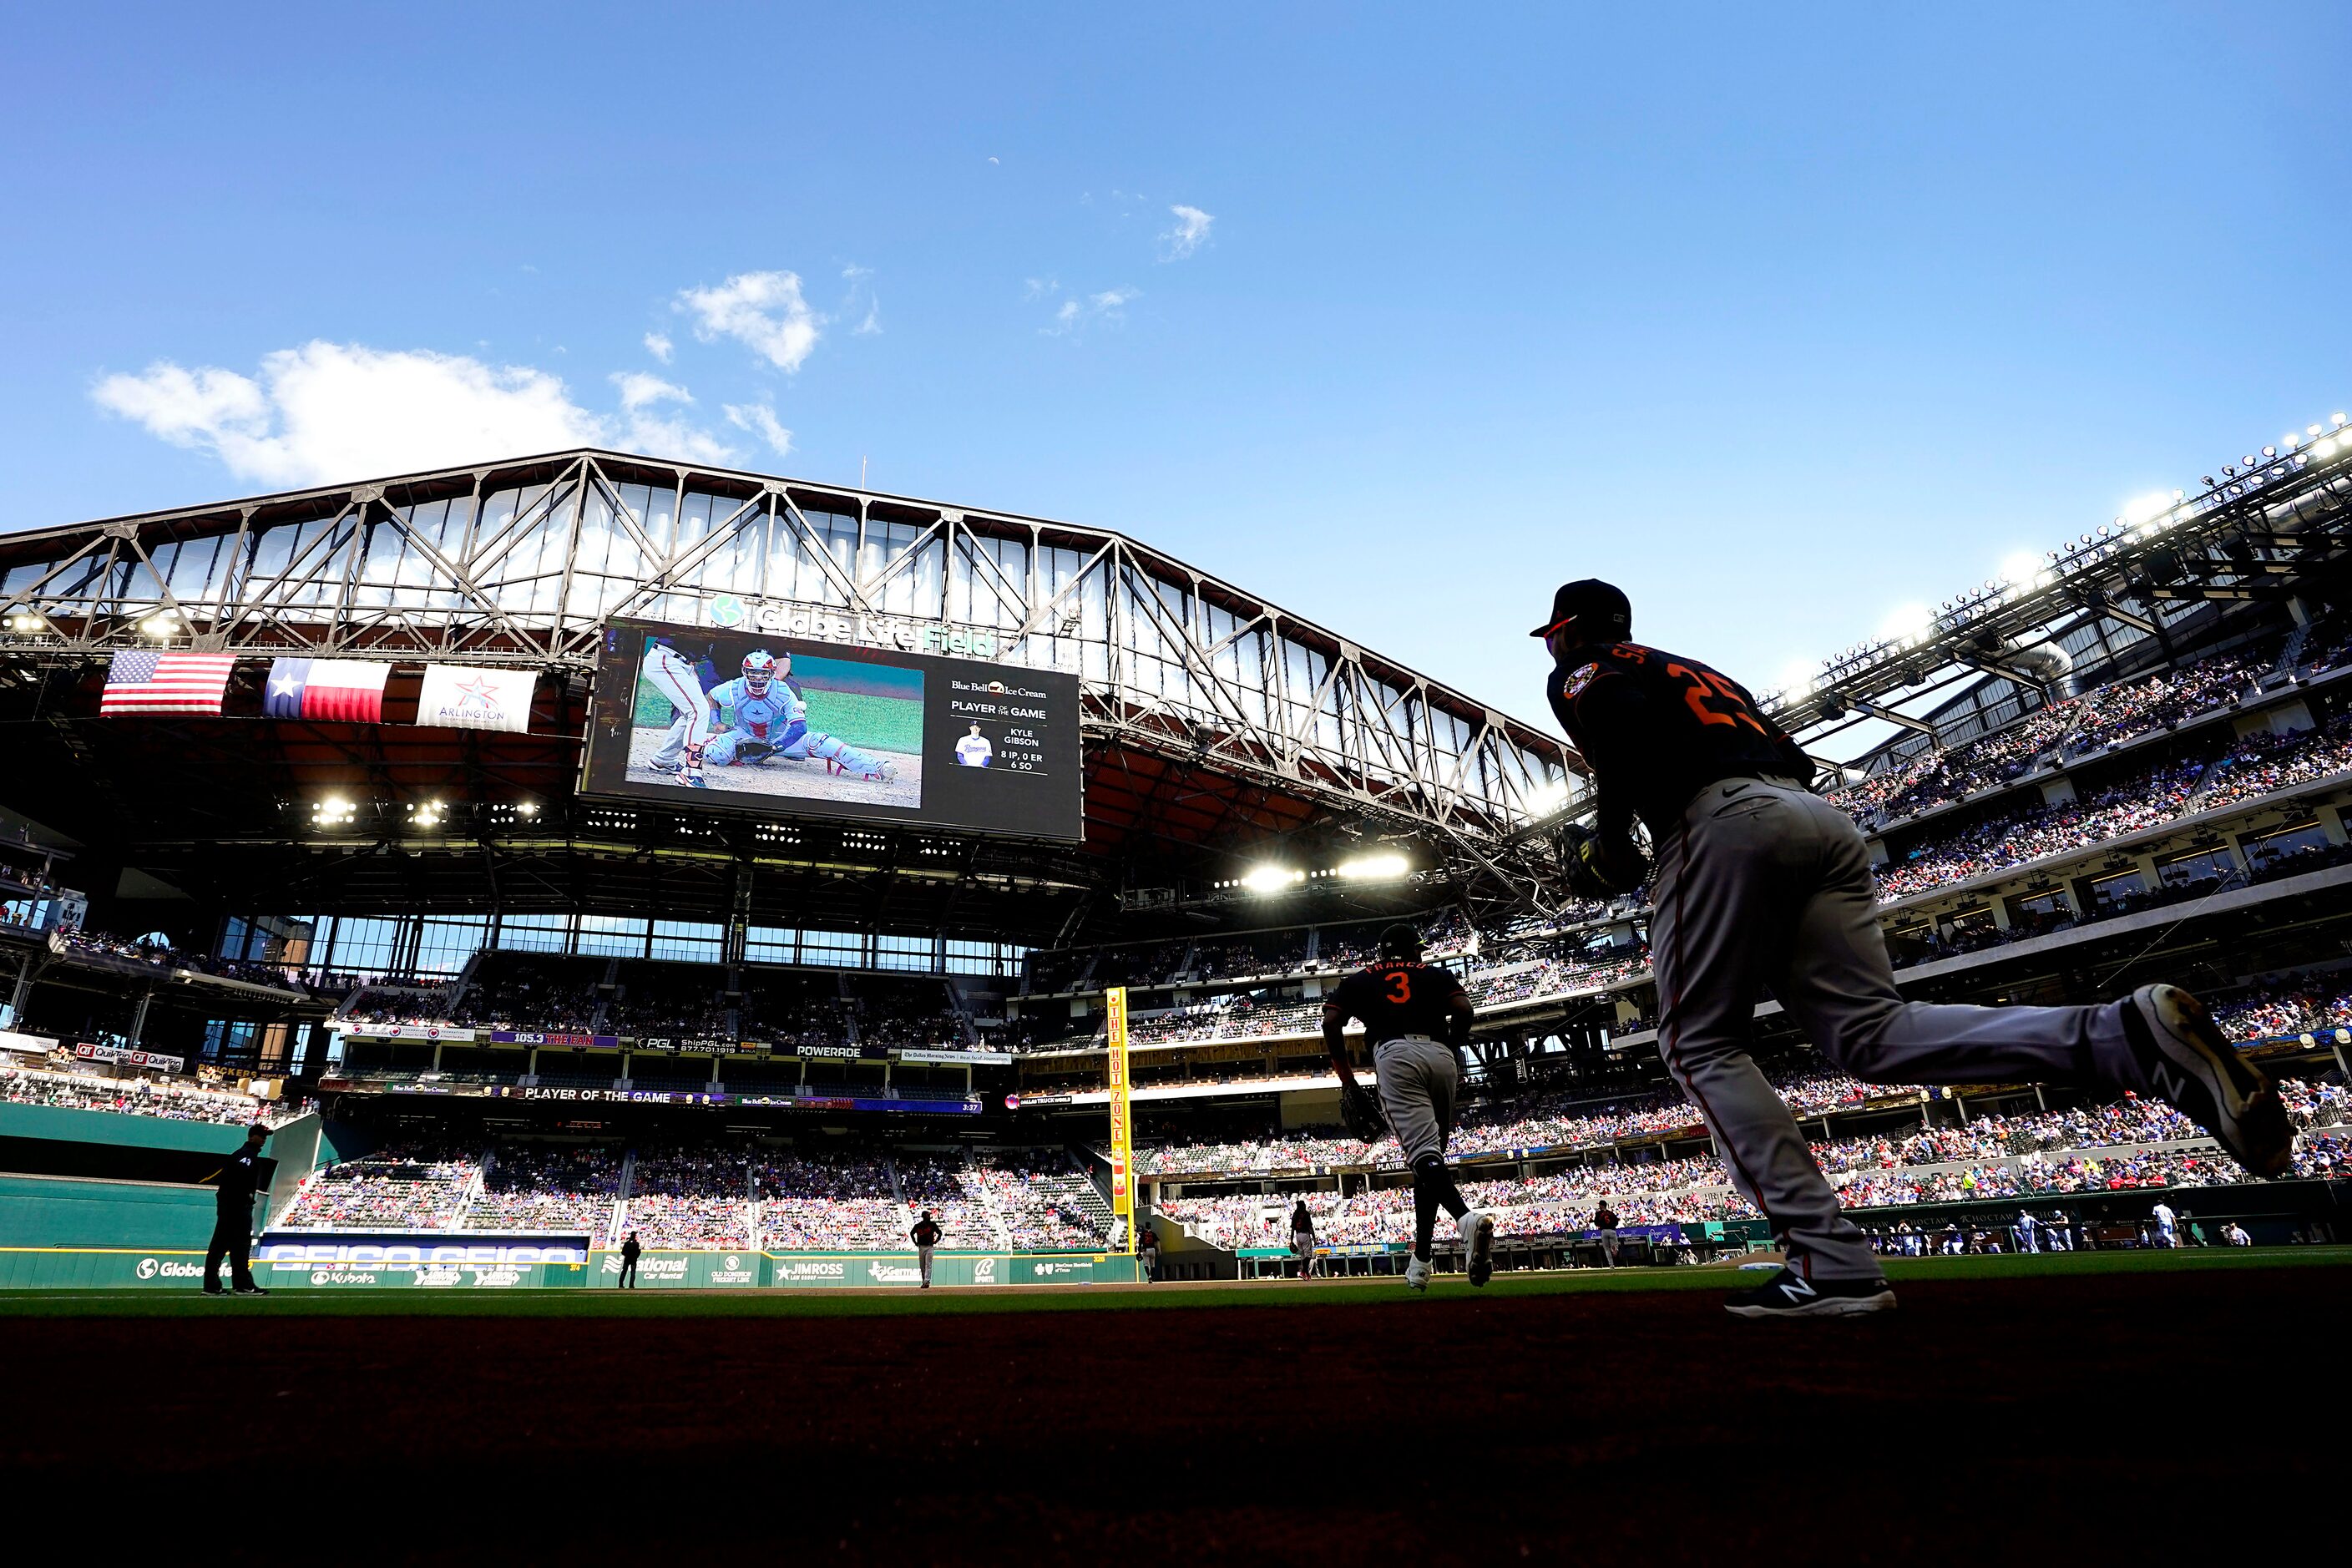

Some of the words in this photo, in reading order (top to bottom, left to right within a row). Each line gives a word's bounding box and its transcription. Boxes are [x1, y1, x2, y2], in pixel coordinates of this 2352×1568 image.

[755, 604, 852, 639] Globe
[857, 616, 916, 648] Life
[923, 626, 993, 658] Field
[951, 680, 970, 690] Blue
[970, 682, 989, 692] Bell
[1004, 685, 1017, 695] Ice
[1018, 688, 1047, 699] Cream
[1667, 663, 1769, 737] 25
[439, 706, 504, 721] ARLINGTON
[951, 701, 996, 714] PLAYER
[1010, 707, 1046, 720] GAME
[1010, 728, 1033, 737] KYLE
[1004, 736, 1039, 747] GIBSON
[1009, 751, 1020, 761] IP,
[1022, 752, 1029, 761] 0
[1030, 754, 1043, 762] ER
[1010, 761, 1017, 769] 6
[1019, 762, 1033, 771] SO
[1384, 972, 1411, 1004] 3
[1110, 1008, 1120, 1043] THE
[514, 1033, 544, 1044] 105.3
[546, 1034, 568, 1044] THE
[569, 1035, 594, 1046] FAN
[646, 1038, 675, 1049] PGL
[680, 1039, 736, 1049] ShipPGL.com
[680, 1045, 736, 1054] 877.701.1919
[797, 1045, 861, 1058] POWERADE
[1112, 1049, 1121, 1085] HOT
[1515, 1059, 1523, 1080] TRULY
[524, 1087, 577, 1100] PLAYER
[580, 1090, 600, 1100] OF
[604, 1090, 629, 1102] THE
[633, 1091, 670, 1104] GAME
[962, 1103, 979, 1111] 3:37
[1818, 1108, 1828, 1116] Bell
[1844, 1104, 1863, 1112] Cream
[1114, 1091, 1123, 1141] ZONE
[1376, 1161, 1405, 1171] PLAYER
[1444, 1156, 1461, 1165] AME
[1961, 1212, 2015, 1223] CHOCTAW
[1855, 1221, 1889, 1230] OCTAW
[267, 1244, 421, 1272] GEICO
[429, 1245, 576, 1272] GEICO
[621, 1257, 689, 1272] ational.
[159, 1262, 205, 1277] Globe
[331, 1272, 376, 1284] Kubota
[974, 1275, 995, 1283] SPORTS
